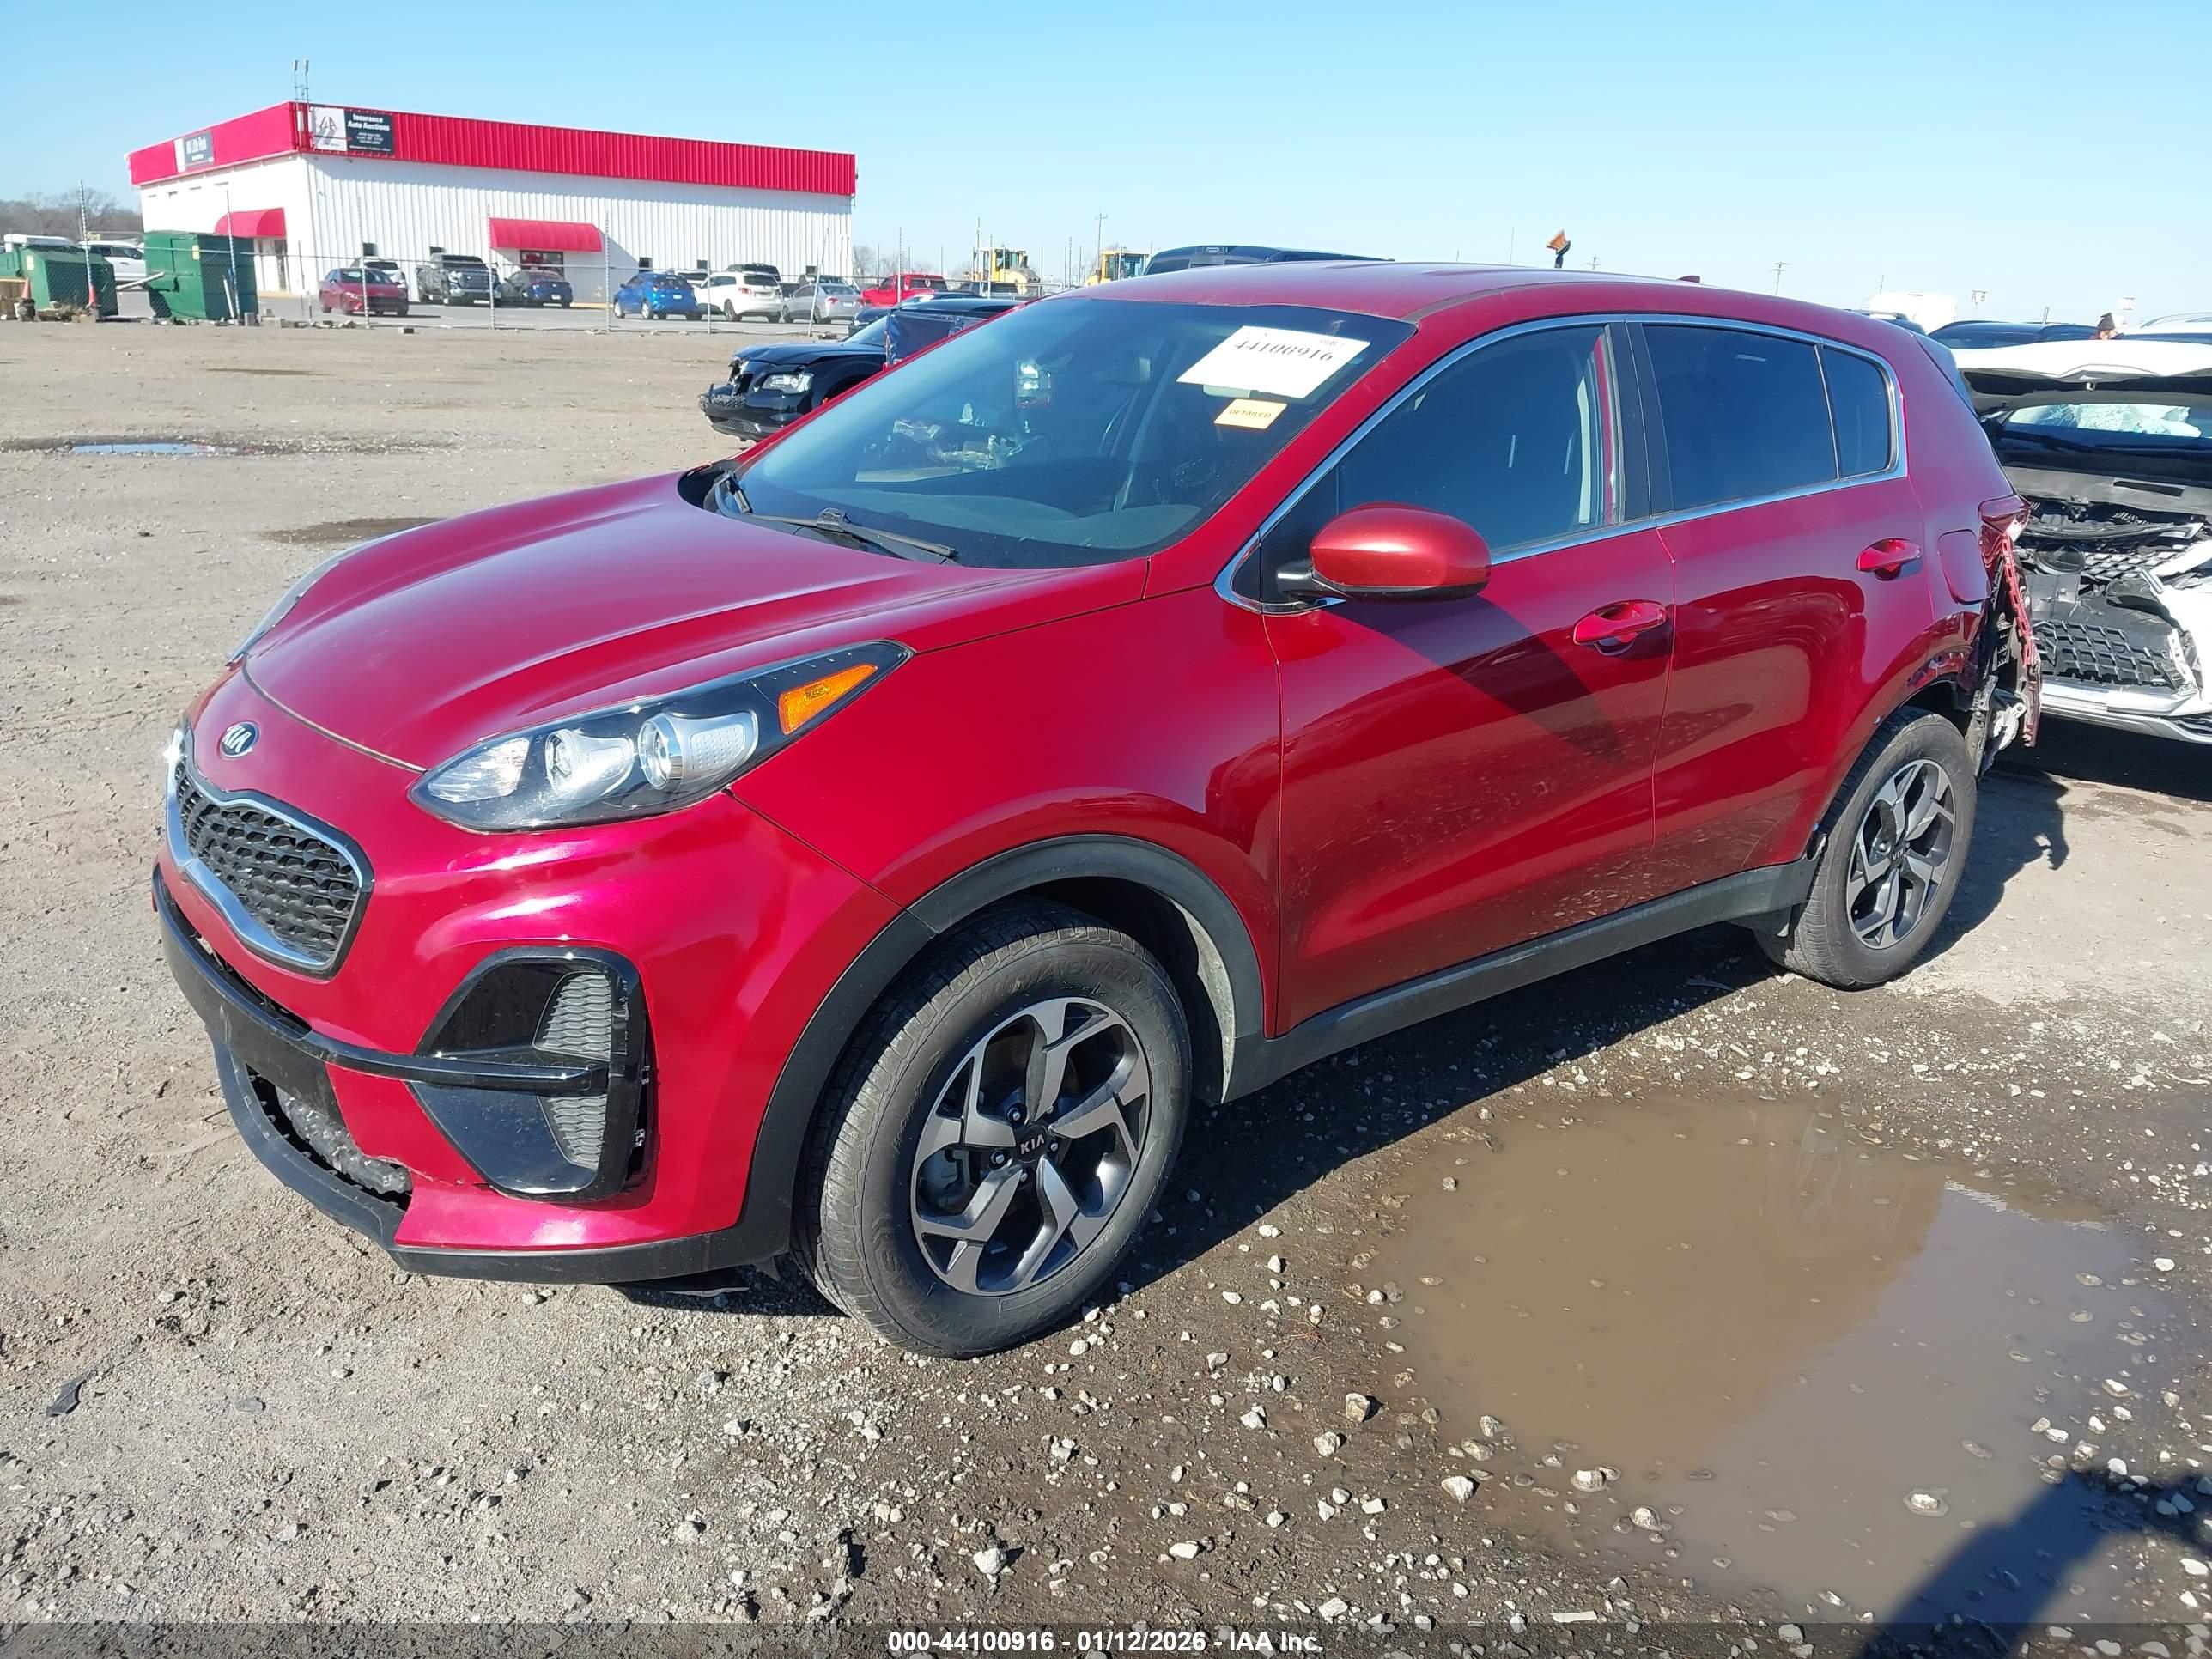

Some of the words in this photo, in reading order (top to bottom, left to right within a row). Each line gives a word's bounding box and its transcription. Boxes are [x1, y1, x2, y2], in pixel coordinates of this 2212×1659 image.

[1234, 340, 1334, 362] 44100916
[1229, 409, 1272, 418] DETAILED
[1020, 1133, 1045, 1155] KIA
